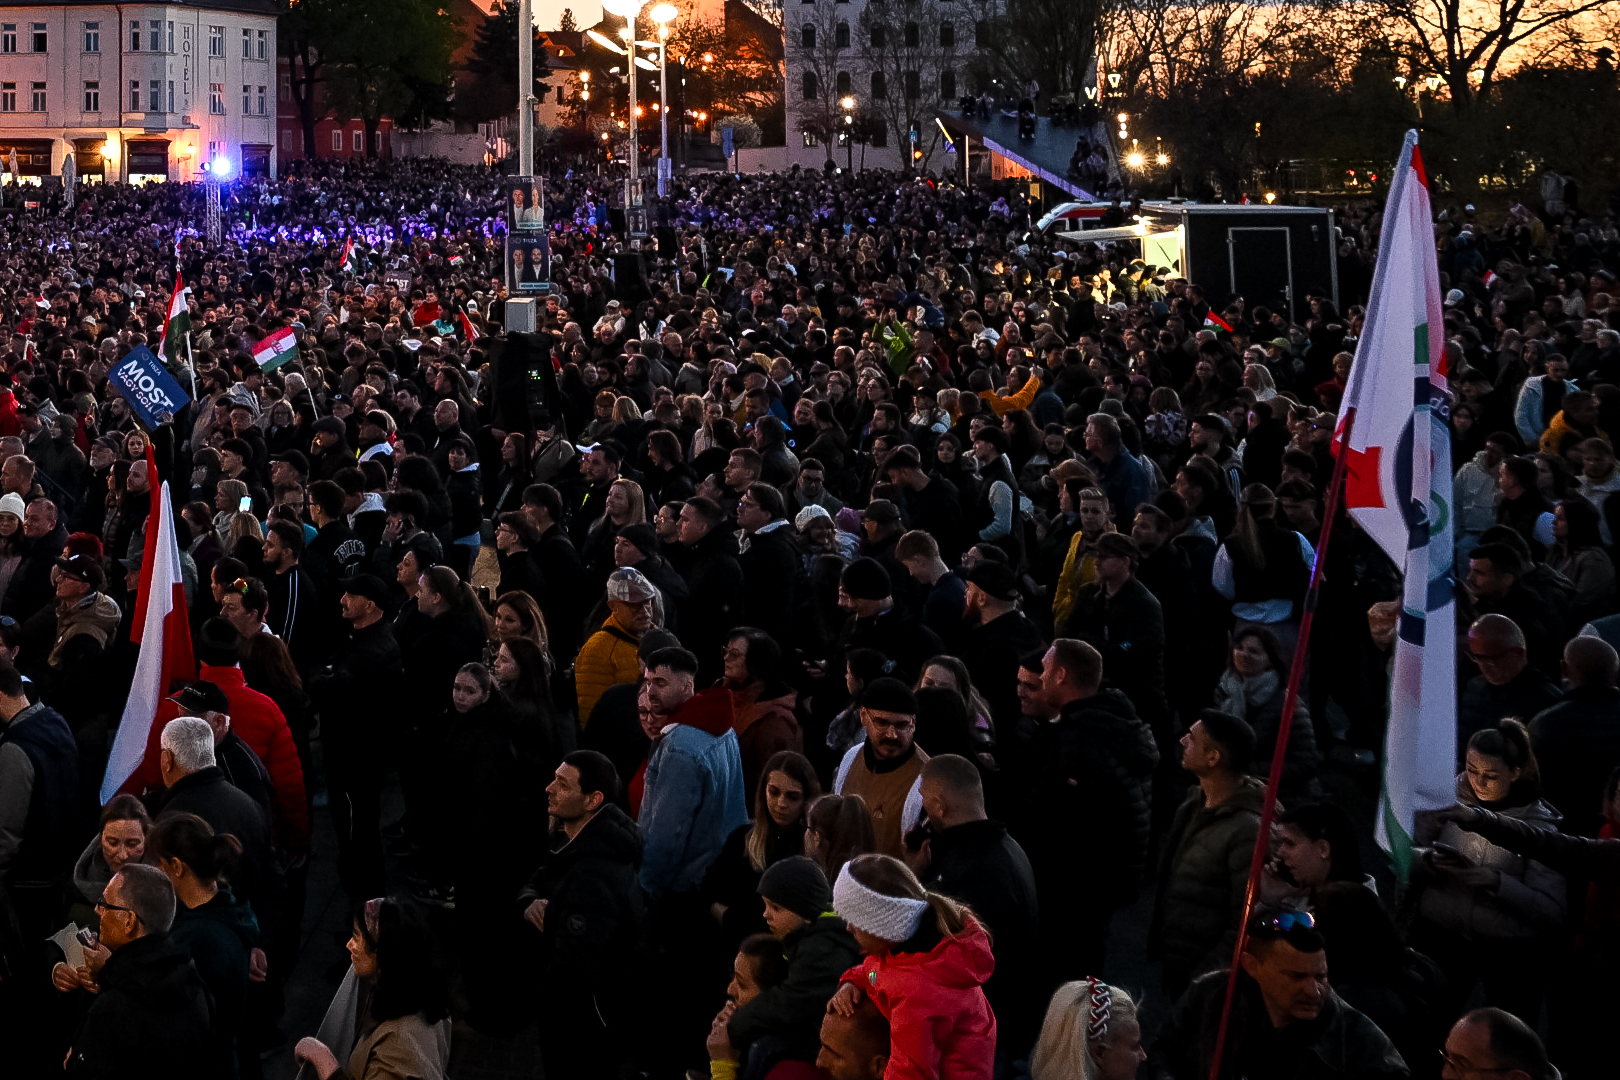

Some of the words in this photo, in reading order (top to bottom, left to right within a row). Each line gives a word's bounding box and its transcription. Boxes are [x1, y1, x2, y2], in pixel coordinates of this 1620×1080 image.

[182, 26, 190, 94] HOTEL
[117, 368, 138, 392] VAGY
[123, 360, 174, 408] MOST
[148, 360, 162, 376] TISZA
